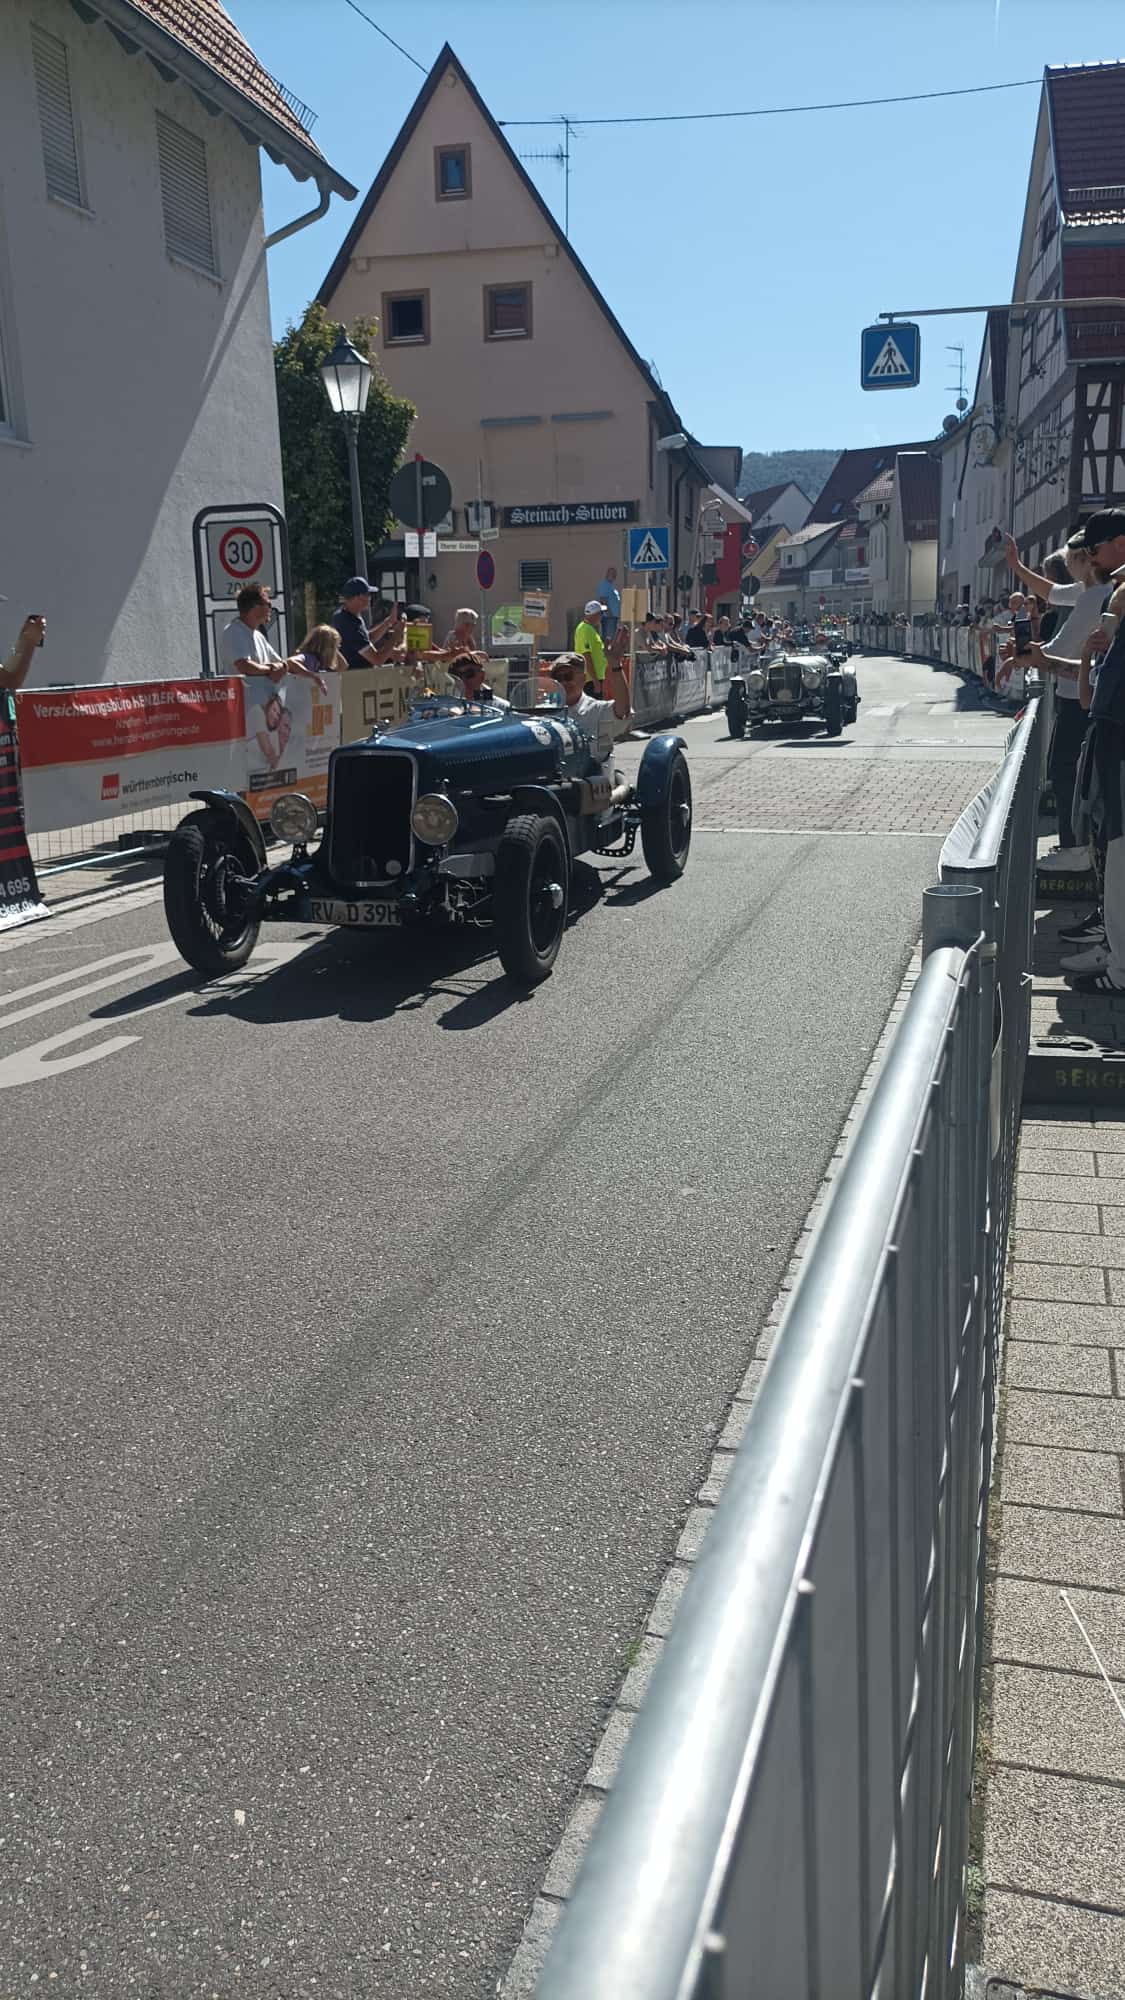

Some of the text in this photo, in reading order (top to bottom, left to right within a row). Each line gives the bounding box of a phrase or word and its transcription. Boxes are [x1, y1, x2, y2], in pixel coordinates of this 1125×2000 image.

[227, 541, 254, 564] 30
[7, 876, 31, 897] 695
[312, 902, 334, 921] RV
[347, 903, 359, 921] D
